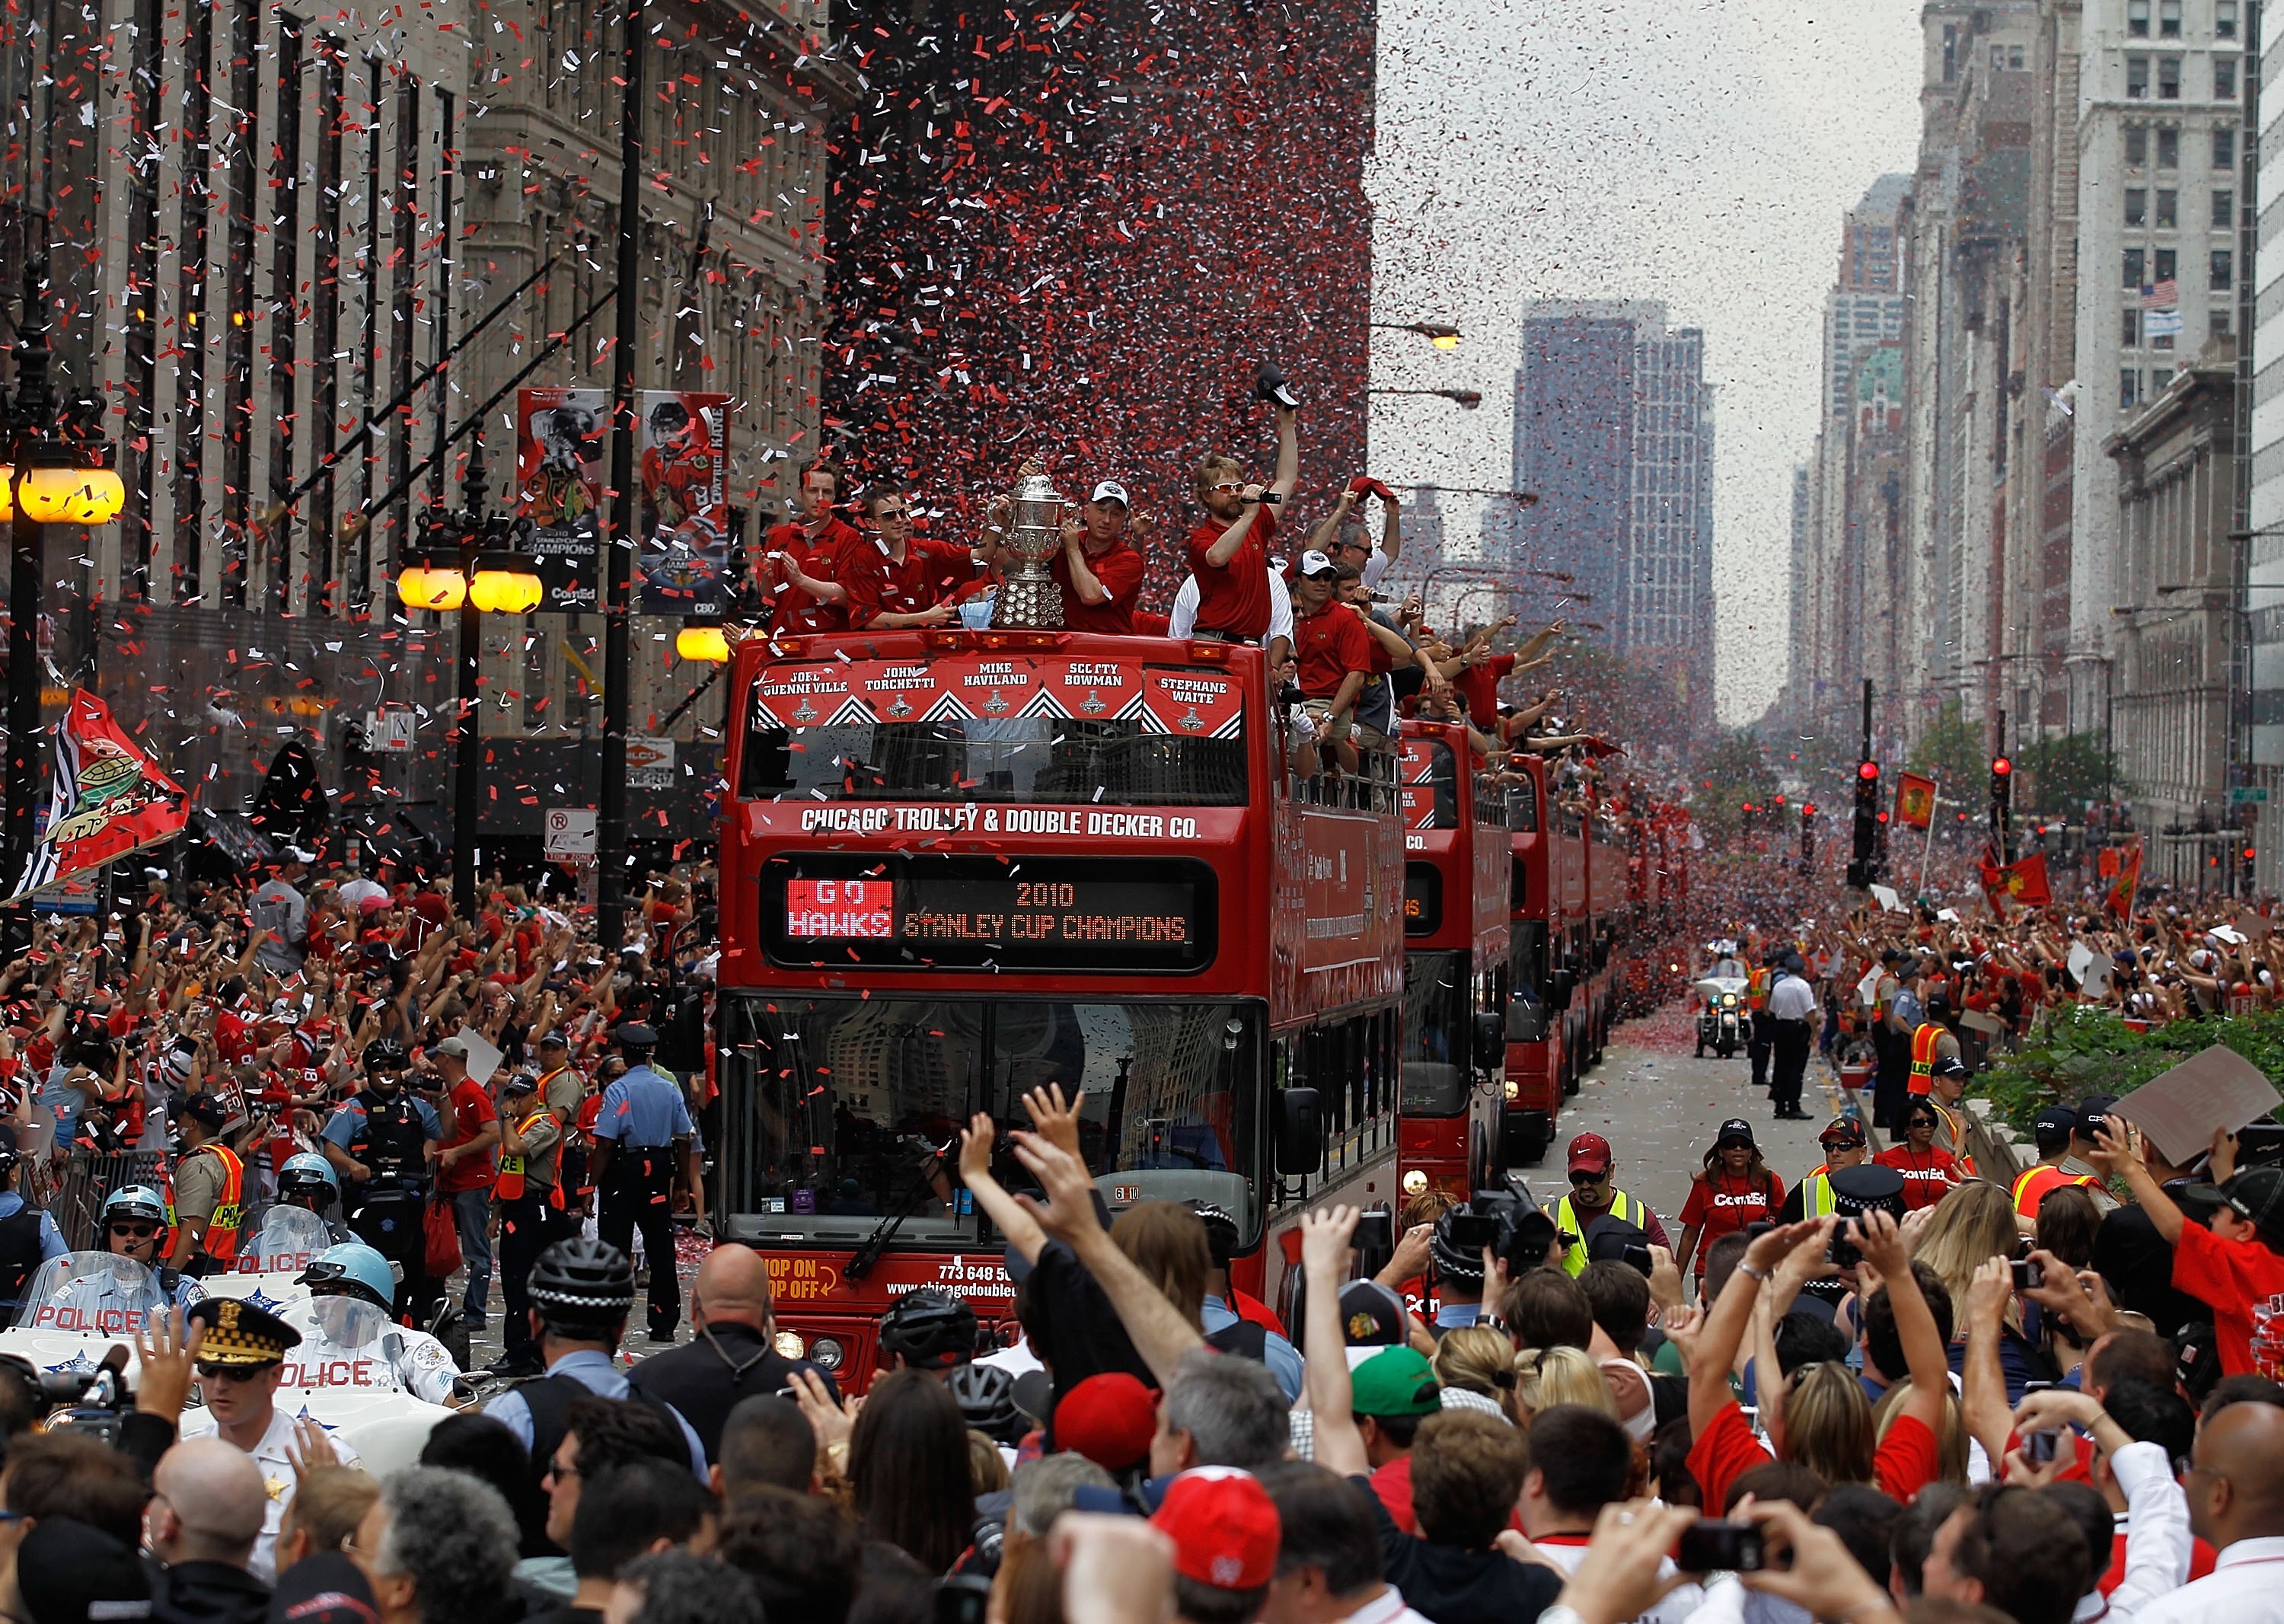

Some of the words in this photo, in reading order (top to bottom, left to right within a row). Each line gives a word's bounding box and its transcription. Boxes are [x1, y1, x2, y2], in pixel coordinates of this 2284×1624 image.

[712, 407, 723, 448] KANE
[713, 451, 723, 495] PATRIC
[528, 544, 595, 555] HAMPIONS
[550, 587, 595, 599] ComEd
[694, 603, 717, 614] CBO
[883, 666, 916, 678] JOHN
[978, 662, 1013, 674] MIKE
[864, 678, 936, 691] TORCHETTI
[963, 674, 1028, 687] HAVILAND
[1064, 675, 1123, 687] BOWMAN
[1160, 678, 1227, 694] STEPHANE
[1172, 691, 1215, 705] WAITE
[801, 808, 891, 831] CHICAGO
[895, 807, 979, 831] TROLLEY
[984, 809, 999, 832] &
[1005, 809, 1082, 834] DOUBLE
[1087, 812, 1163, 838] DECKER
[1169, 817, 1202, 838] CO.
[1405, 835, 1428, 850] CO.
[816, 880, 864, 904] GO
[1016, 882, 1074, 907] 2010
[788, 911, 890, 936] HAWKS
[904, 913, 1004, 938] STANLEY
[1011, 914, 1055, 939] CUP
[1063, 915, 1185, 941] CHAMPIONS
[2088, 1115, 2105, 1123] CP
[1896, 1167, 1945, 1181] ComEd
[1116, 1188, 1122, 1199] 6
[1131, 1188, 1137, 1199] 10
[1714, 1192, 1767, 1207] ComEd
[221, 1252, 311, 1274] POLICE
[793, 1259, 816, 1278] ON
[939, 1265, 965, 1281] 773
[966, 1265, 993, 1281] 648
[790, 1280, 818, 1298] OFF
[35, 1306, 143, 1332] POLICE
[417, 1345, 441, 1361] CHICAGO
[276, 1361, 373, 1387] OLICE
